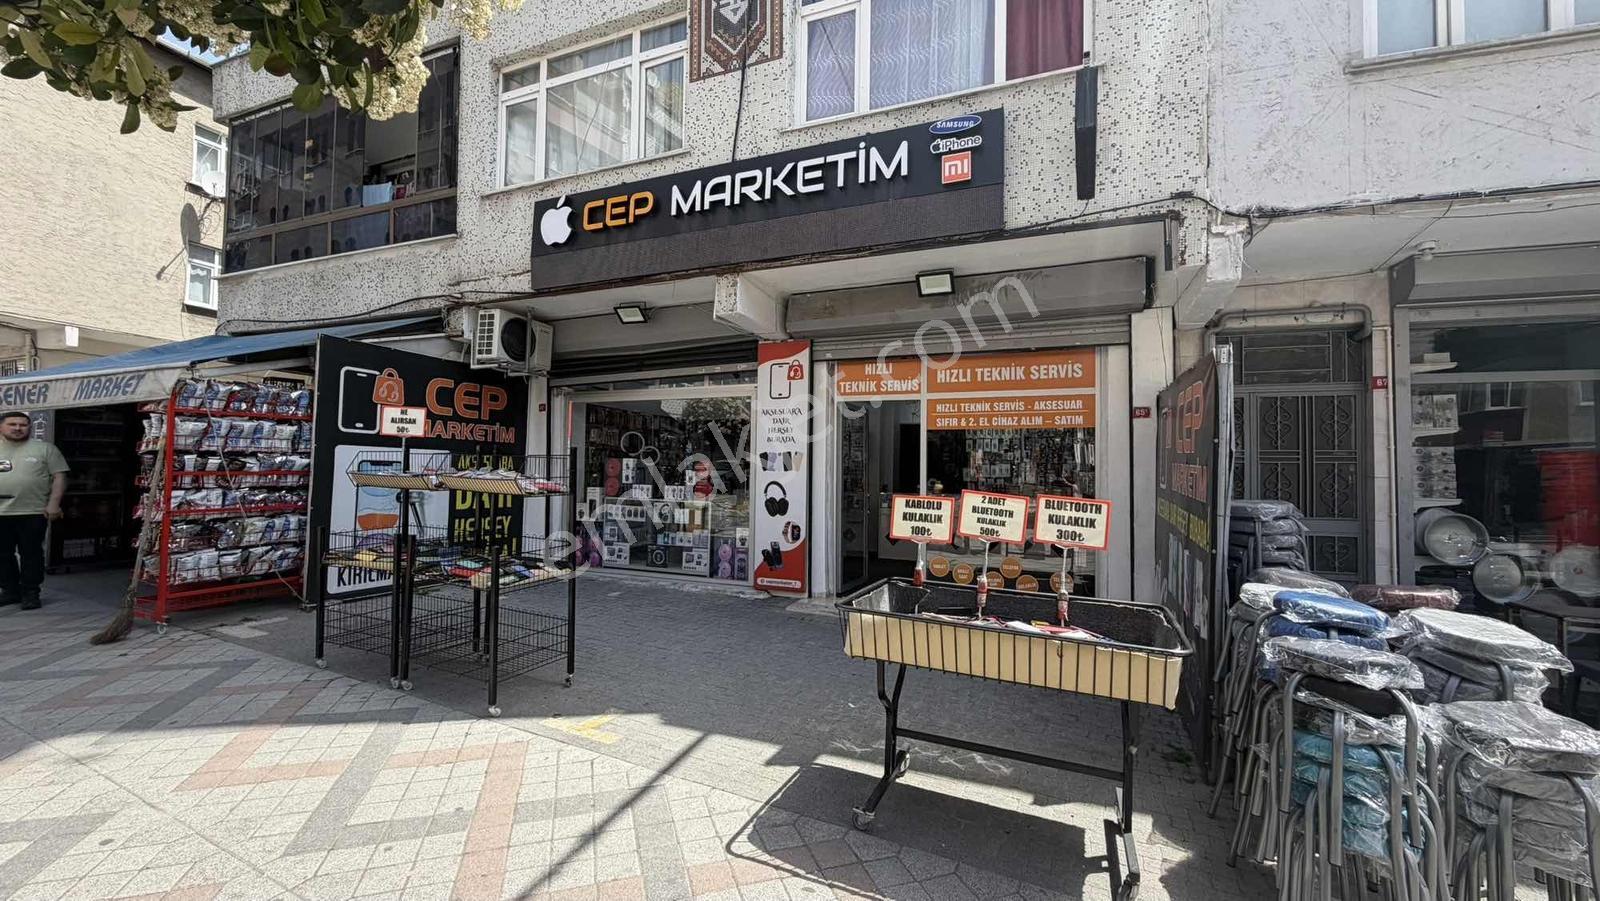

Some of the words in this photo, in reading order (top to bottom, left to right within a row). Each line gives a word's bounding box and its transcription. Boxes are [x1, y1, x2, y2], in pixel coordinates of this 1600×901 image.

[936, 120, 974, 129] SAMSUNG
[942, 136, 981, 151] iPhone
[581, 190, 654, 232] CEP
[670, 141, 908, 216] MARKETİM
[864, 363, 893, 376] HIZLI
[936, 368, 971, 384] HIZLI
[975, 363, 1025, 382] TEKNİK
[1029, 360, 1083, 380] SERVİS
[73, 373, 146, 401] MARKET
[839, 379, 876, 393] TEKNİK
[880, 376, 919, 392] SERVİS
[425, 377, 507, 421] CEP
[936, 402, 959, 413] HIZLI
[961, 400, 991, 412] TEKNİK
[993, 399, 1025, 412] SERVİS
[1034, 400, 1083, 411] AKSESUAR
[936, 417, 958, 427] SIFIR
[979, 417, 989, 426] EL
[991, 414, 1019, 426] CİHAZ
[1020, 415, 1043, 425] ALIM
[1054, 415, 1083, 425] SATIM
[904, 498, 942, 511] KABLOLU
[981, 495, 987, 504] 2
[987, 496, 1007, 506] ADET
[1044, 499, 1103, 515] BLUETOOTH
[902, 511, 943, 524] KULAKLIK
[971, 505, 1014, 518] BLUETOOTH
[976, 517, 1007, 528] KULAKLIK
[1048, 513, 1096, 529] KULAKLIK
